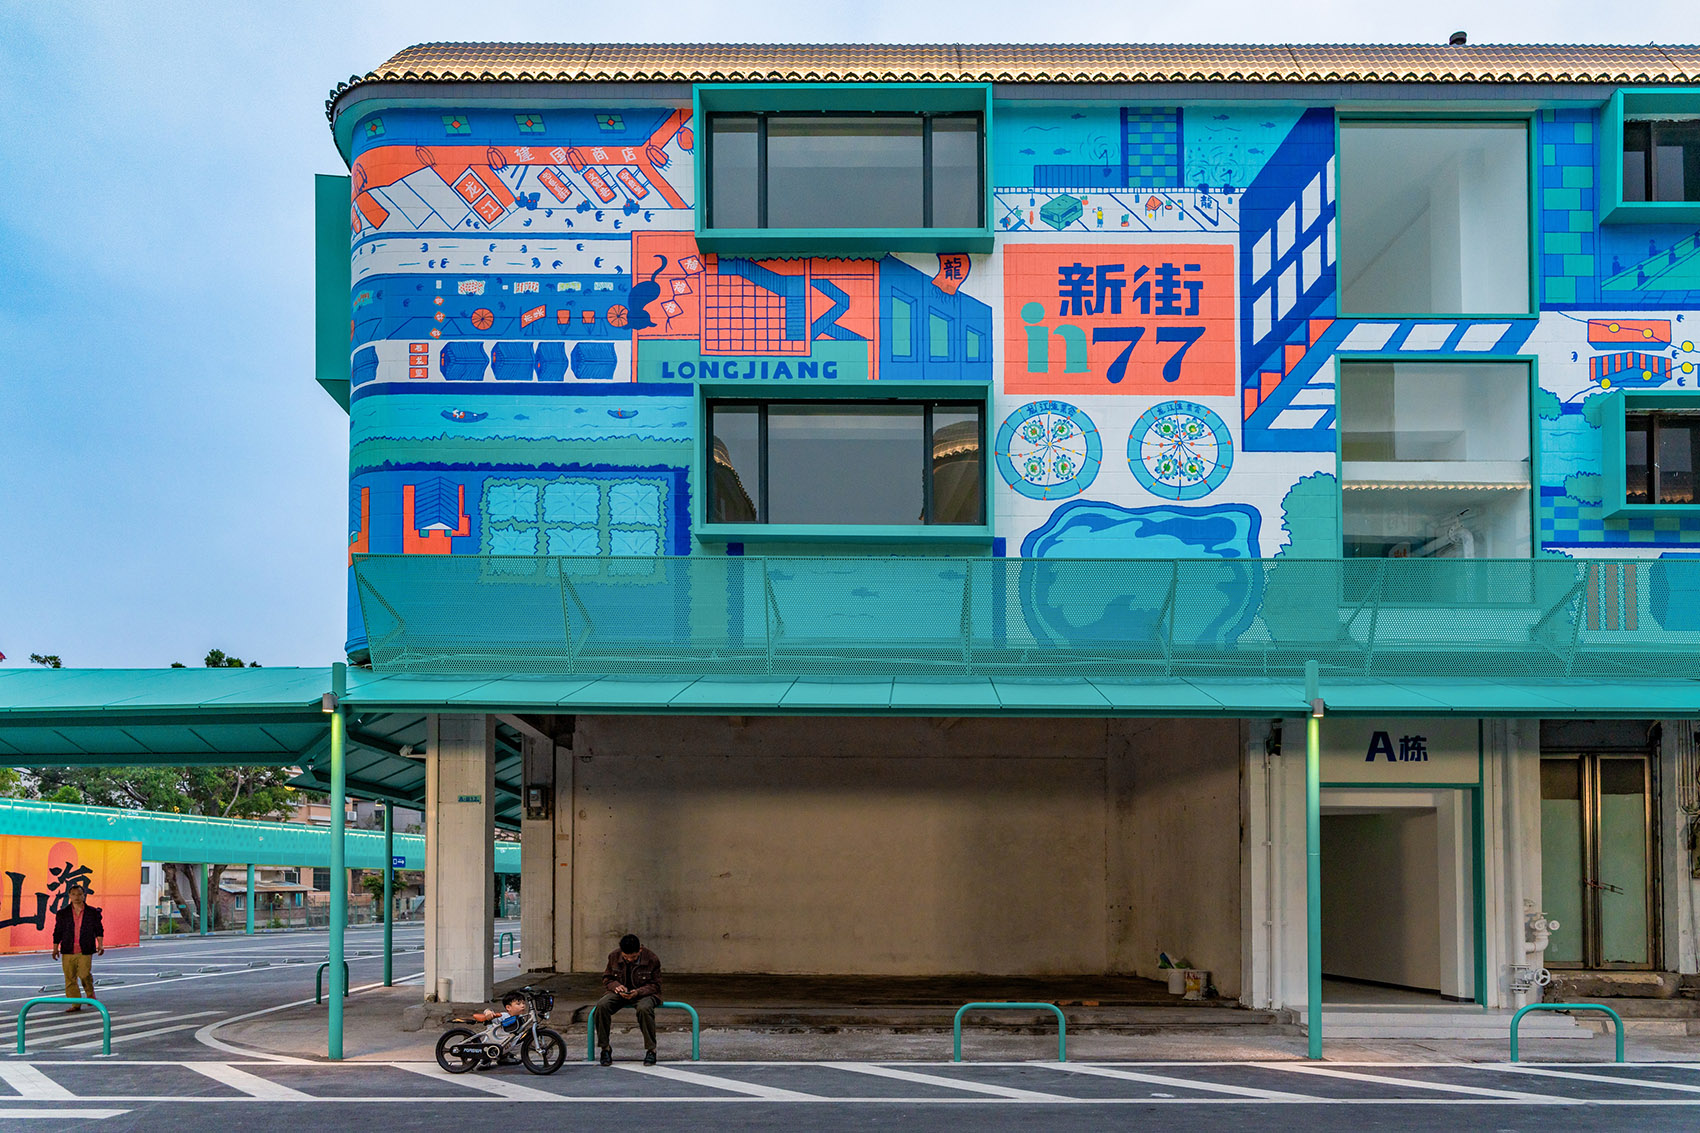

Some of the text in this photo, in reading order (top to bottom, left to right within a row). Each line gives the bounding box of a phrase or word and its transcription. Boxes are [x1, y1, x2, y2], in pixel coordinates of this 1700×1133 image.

[465, 181, 500, 219] 龙江
[684, 258, 699, 271] 福
[943, 257, 963, 281] 龍
[1058, 262, 1204, 317] 新街
[661, 360, 838, 380] LONGJIANG
[1365, 731, 1428, 762] A栋
[0, 861, 94, 931] 山海
